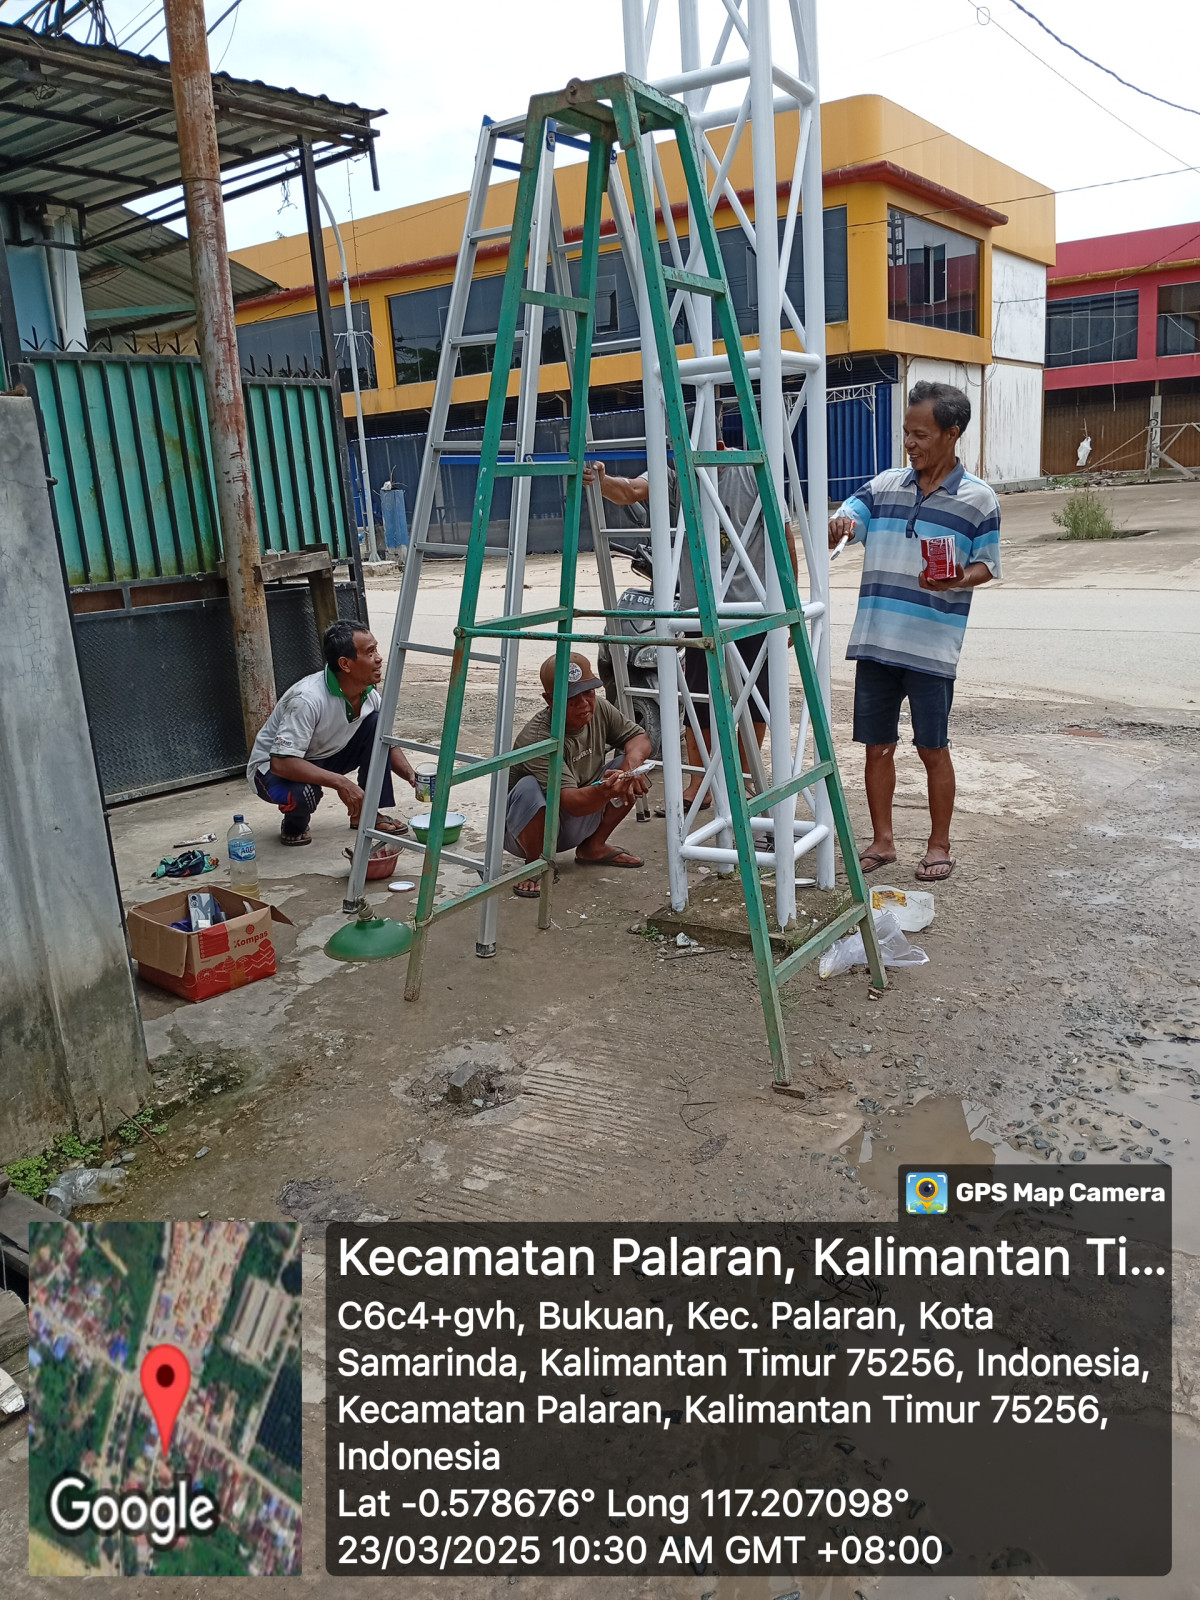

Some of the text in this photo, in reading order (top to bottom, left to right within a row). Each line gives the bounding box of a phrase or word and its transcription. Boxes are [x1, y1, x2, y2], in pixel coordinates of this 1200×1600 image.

[622, 593, 655, 606] KT 661
[233, 930, 268, 949] Kompas
